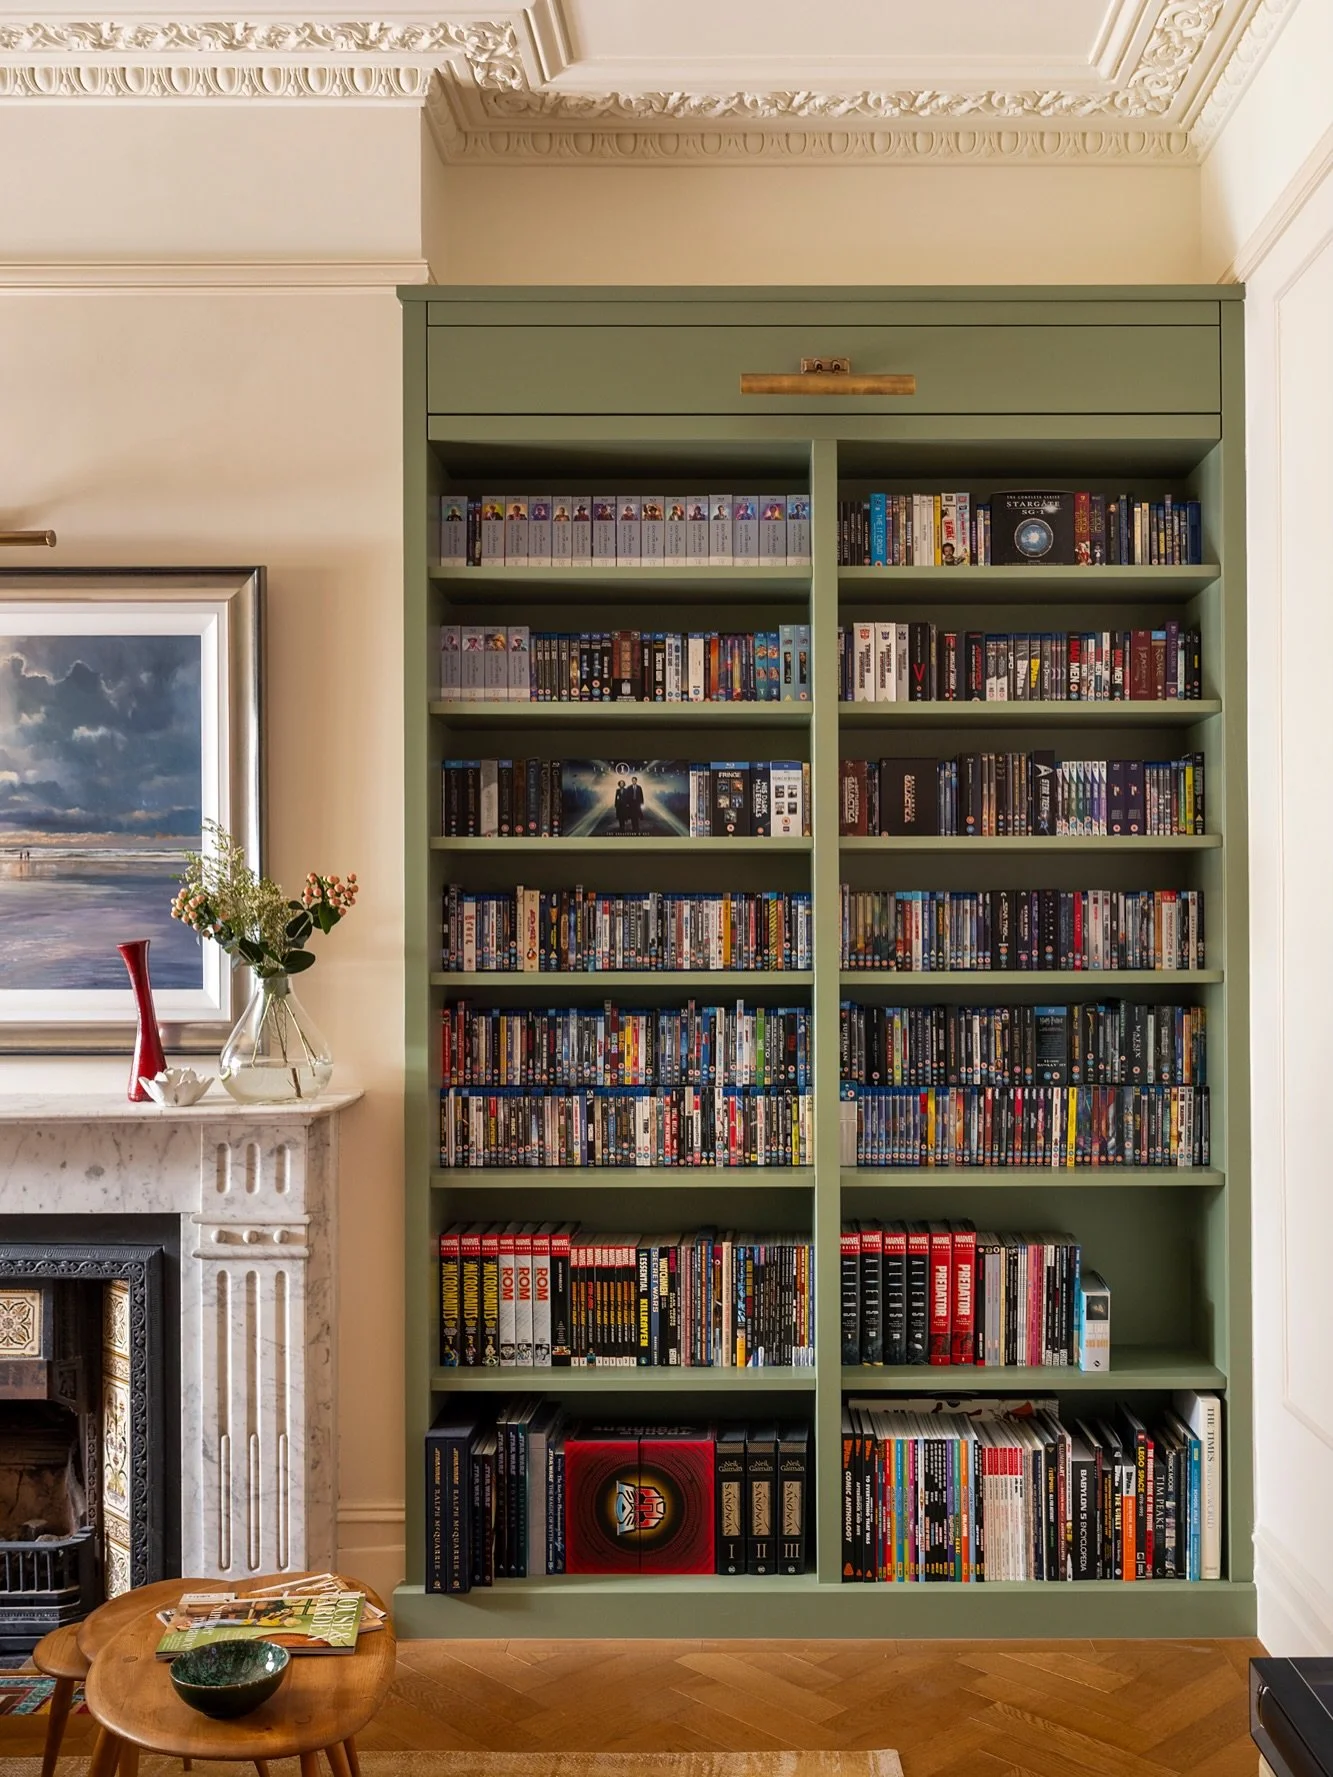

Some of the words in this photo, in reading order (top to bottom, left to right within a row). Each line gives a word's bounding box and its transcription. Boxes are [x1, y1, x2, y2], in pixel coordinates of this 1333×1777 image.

[1070, 640, 1080, 662] MAD
[1114, 650, 1122, 667] MAD
[1070, 662, 1080, 683] MEN
[1114, 667, 1122, 684] MEN
[1042, 778, 1050, 794] STAR
[1042, 796, 1050, 811] TREK
[442, 1263, 458, 1318] MICRONAUTS
[464, 1263, 478, 1318] MICRONAUTS
[484, 1263, 498, 1318] MICRONAUTS
[503, 1268, 513, 1300] ROM
[519, 1268, 530, 1300] ROM
[537, 1268, 548, 1300] ROM
[660, 1258, 668, 1296] WATCHMEN
[843, 1261, 856, 1317] ALIENS
[866, 1259, 878, 1315] ALIENS
[889, 1262, 902, 1318] ALIENS
[912, 1260, 924, 1317] ALIENS
[935, 1266, 947, 1316] PREDATOR
[958, 1264, 970, 1315] PREDATOR
[640, 1299, 648, 1346] KILLRAVEN
[1167, 1451, 1175, 1472] PATRICK
